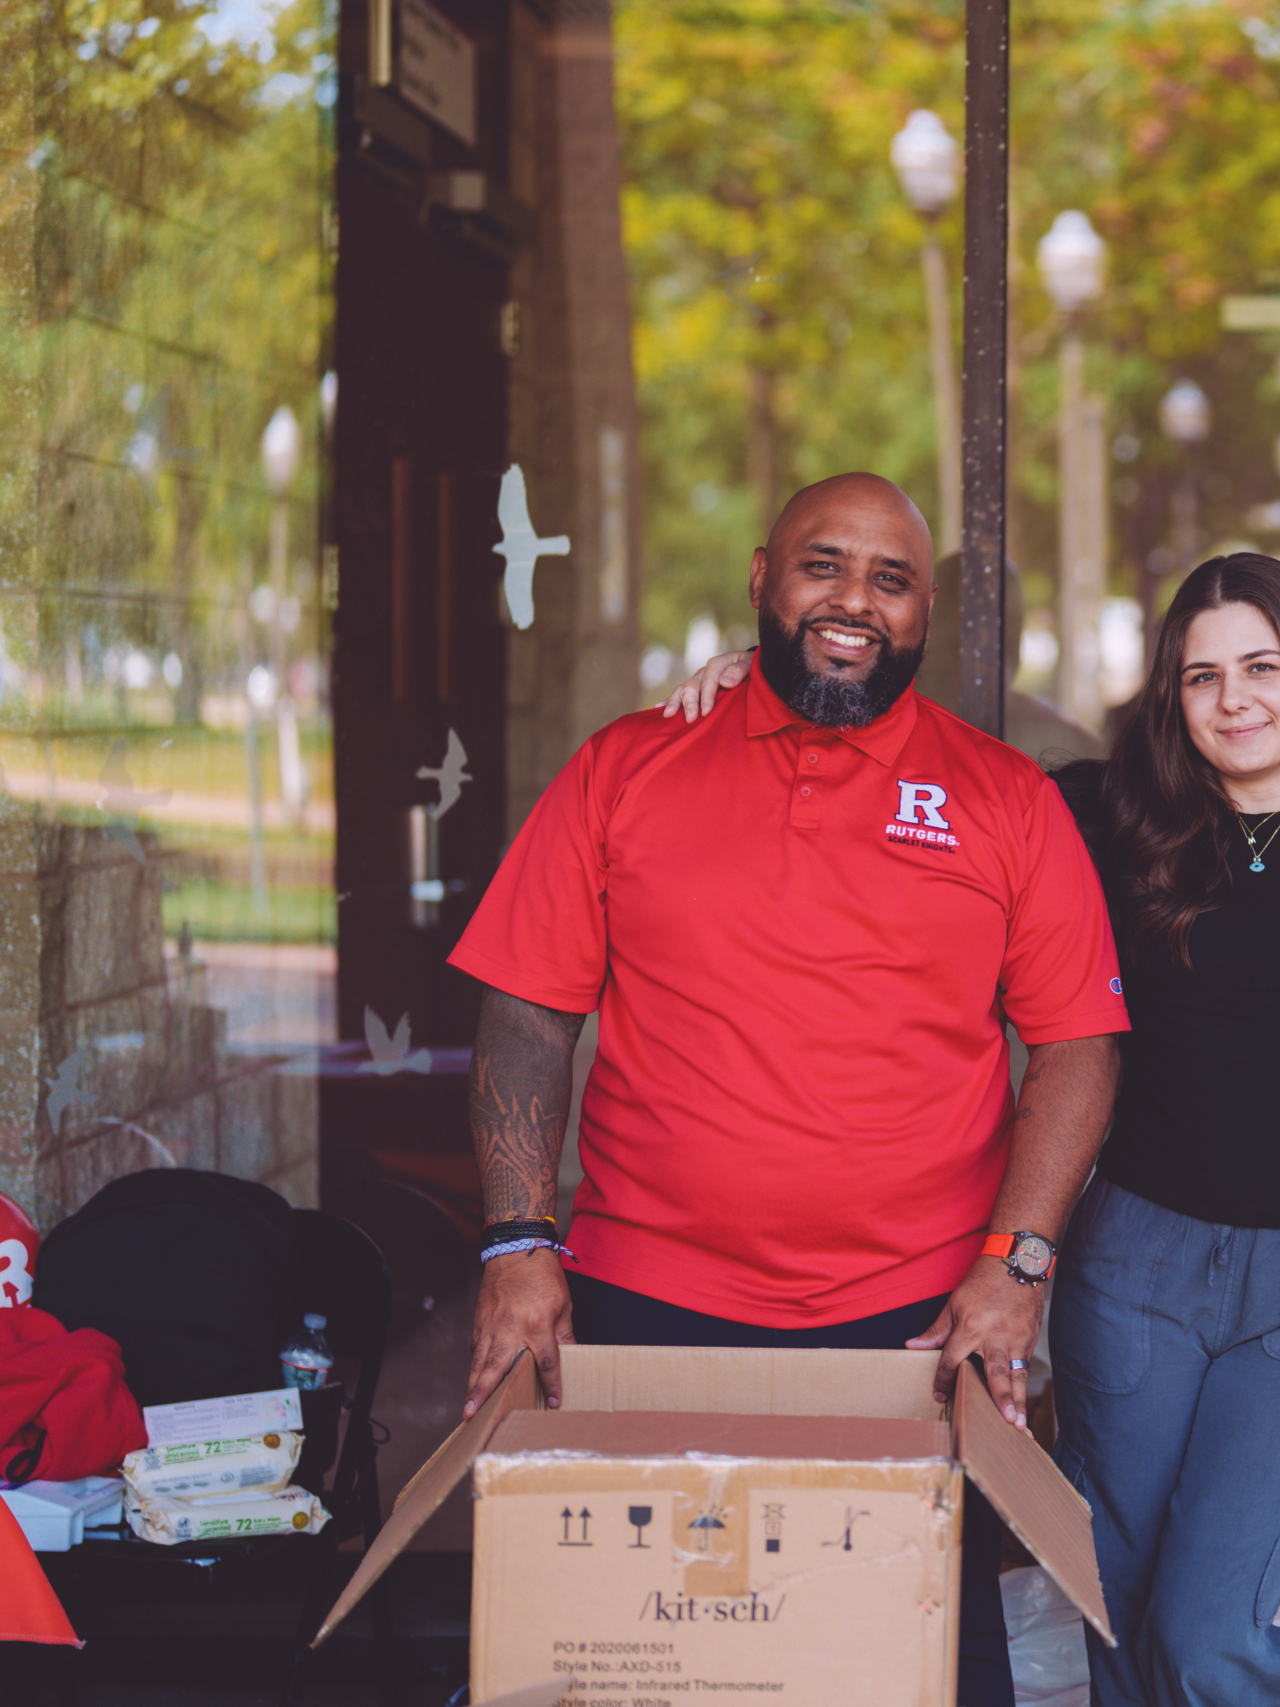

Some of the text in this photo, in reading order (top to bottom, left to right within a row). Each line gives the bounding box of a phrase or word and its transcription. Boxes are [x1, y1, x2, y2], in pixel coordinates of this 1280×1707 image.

[895, 779, 950, 831] R
[885, 824, 957, 846] RUTGERS
[887, 836, 953, 854] SCARLET KNIGHTS
[204, 1441, 222, 1454] 72
[236, 1518, 252, 1531] 72
[553, 1642, 675, 1655] PO # 2020061501
[553, 1660, 588, 1675] Style
[590, 1680, 633, 1691] name:
[636, 1679, 690, 1691] Infrared
[694, 1680, 784, 1692] Thermometer
[631, 1698, 671, 1707] White
